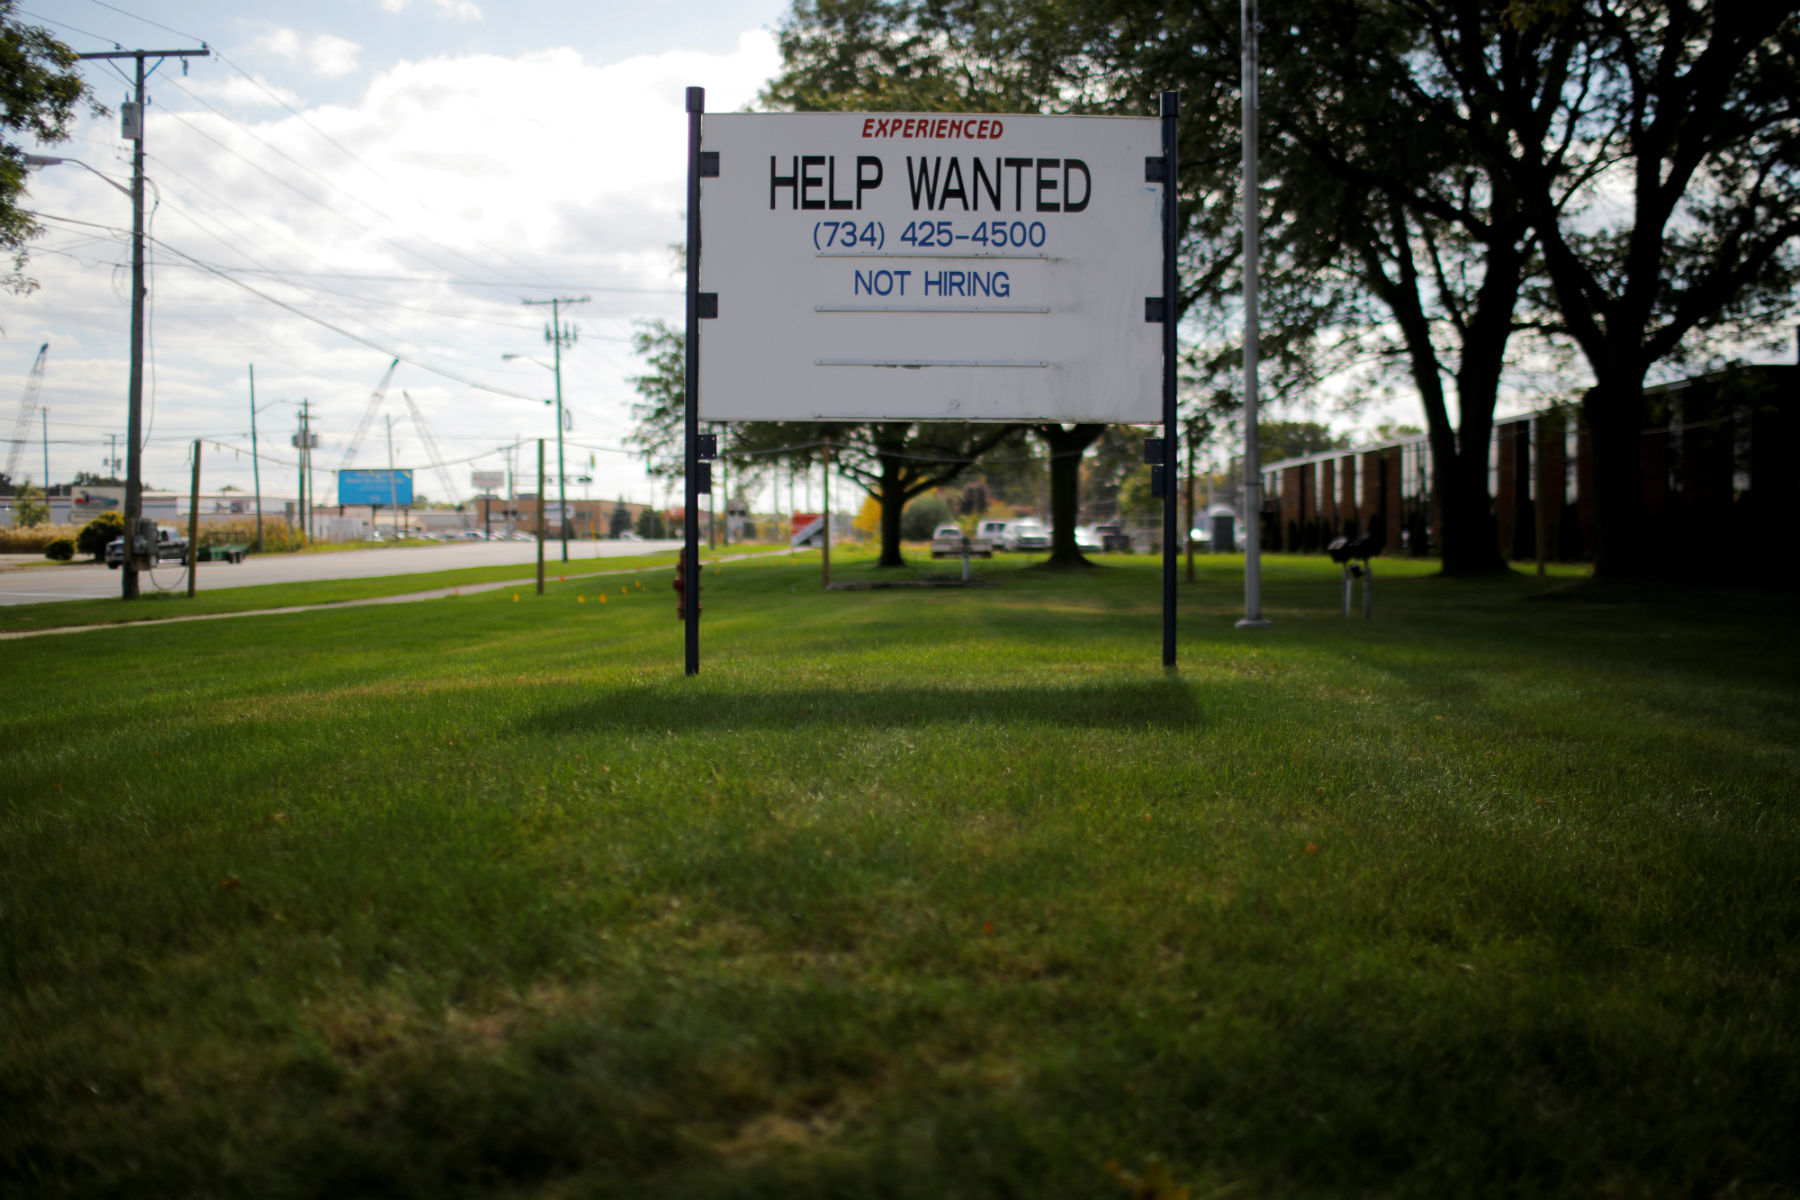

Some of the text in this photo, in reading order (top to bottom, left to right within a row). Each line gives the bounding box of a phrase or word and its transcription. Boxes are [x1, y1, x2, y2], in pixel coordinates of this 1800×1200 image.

[861, 118, 1004, 140] EXPERIENCED
[769, 154, 1092, 213] HELP WANTED
[813, 220, 1047, 251] (734) 425-4500
[854, 269, 1011, 298] NOT HIRING
